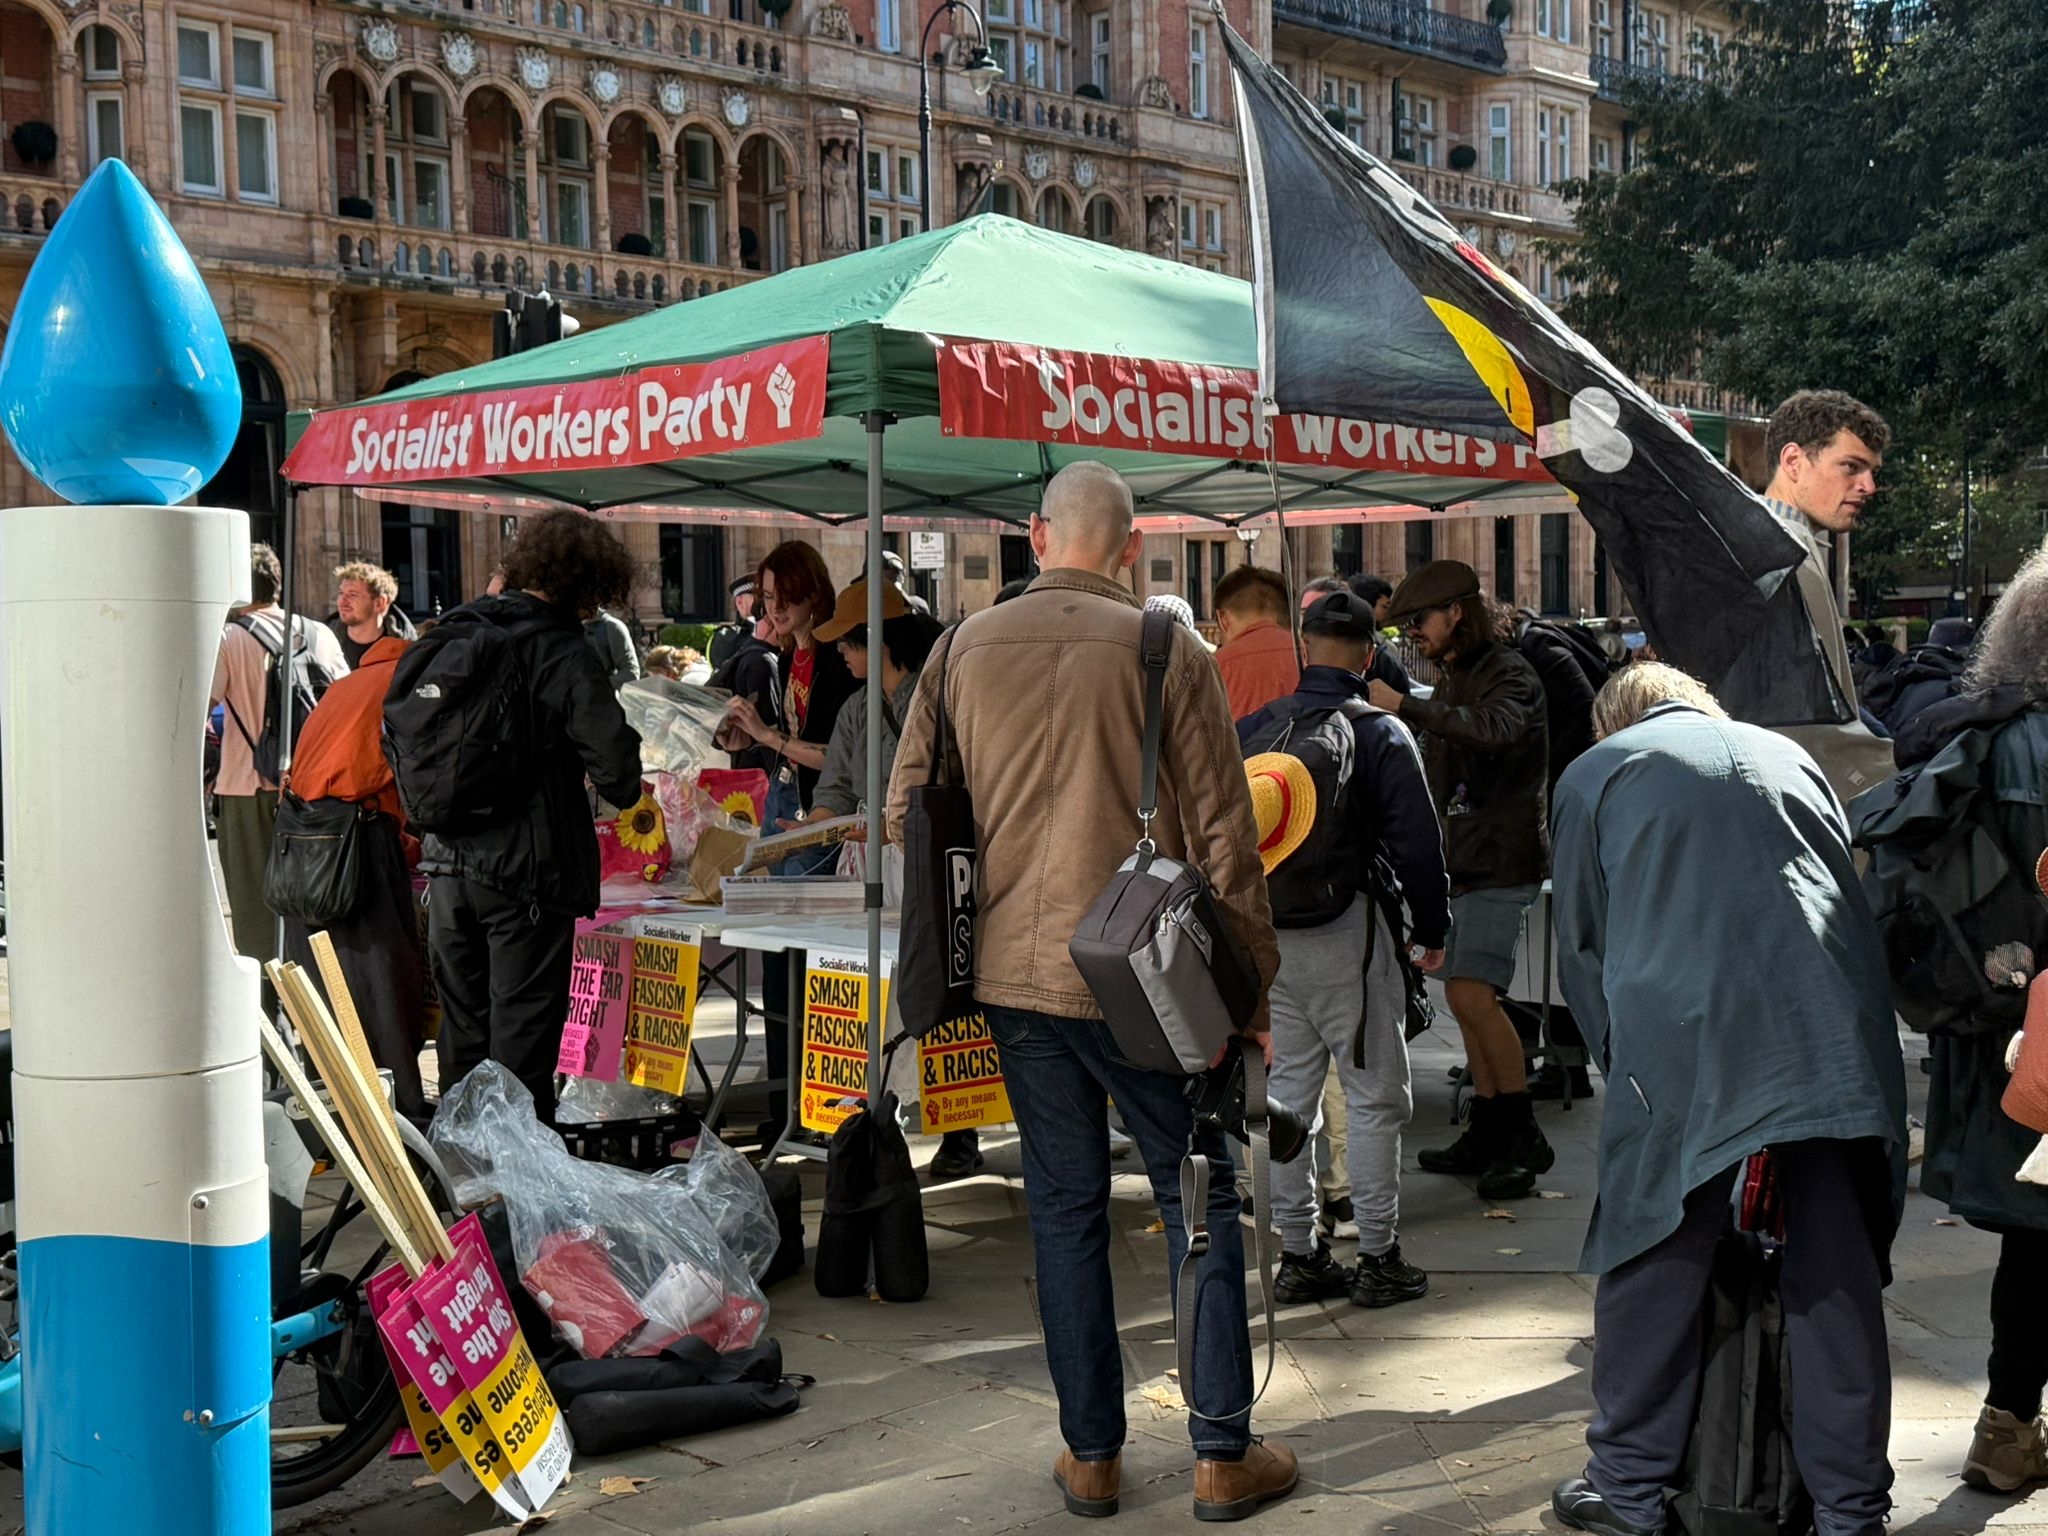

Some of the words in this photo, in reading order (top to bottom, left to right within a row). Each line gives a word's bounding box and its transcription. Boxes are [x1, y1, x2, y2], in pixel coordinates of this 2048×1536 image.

[1042, 362, 1268, 448] Socialist
[345, 411, 473, 474] Socialist
[483, 394, 630, 465] Workers
[638, 376, 751, 451] Party
[574, 936, 620, 969] SMASH
[643, 925, 669, 940] Socialist
[668, 928, 691, 943] Worker
[634, 941, 679, 974] SMASH
[819, 956, 850, 971] Socialist
[849, 960, 868, 974] Work
[571, 966, 598, 996] THE
[598, 969, 623, 1001] FAR
[633, 976, 687, 1013] FASCISM
[809, 974, 860, 1009] SMASH
[567, 996, 608, 1029] RIGHT
[630, 1012, 640, 1039] &
[643, 1016, 691, 1051] RACISM
[807, 1013, 868, 1050] FASCISM
[806, 1051, 816, 1081] &
[821, 1054, 868, 1090] RACIS
[923, 1056, 938, 1086] &
[943, 1046, 999, 1083] RACIS
[942, 1096, 953, 1111] By
[955, 1094, 969, 1109] any
[971, 1091, 997, 1105] means
[943, 1106, 985, 1124] necessary
[485, 1297, 512, 1337] Stop
[462, 1324, 498, 1365] the
[487, 1344, 533, 1415] welcome
[504, 1377, 554, 1454] Refugees
